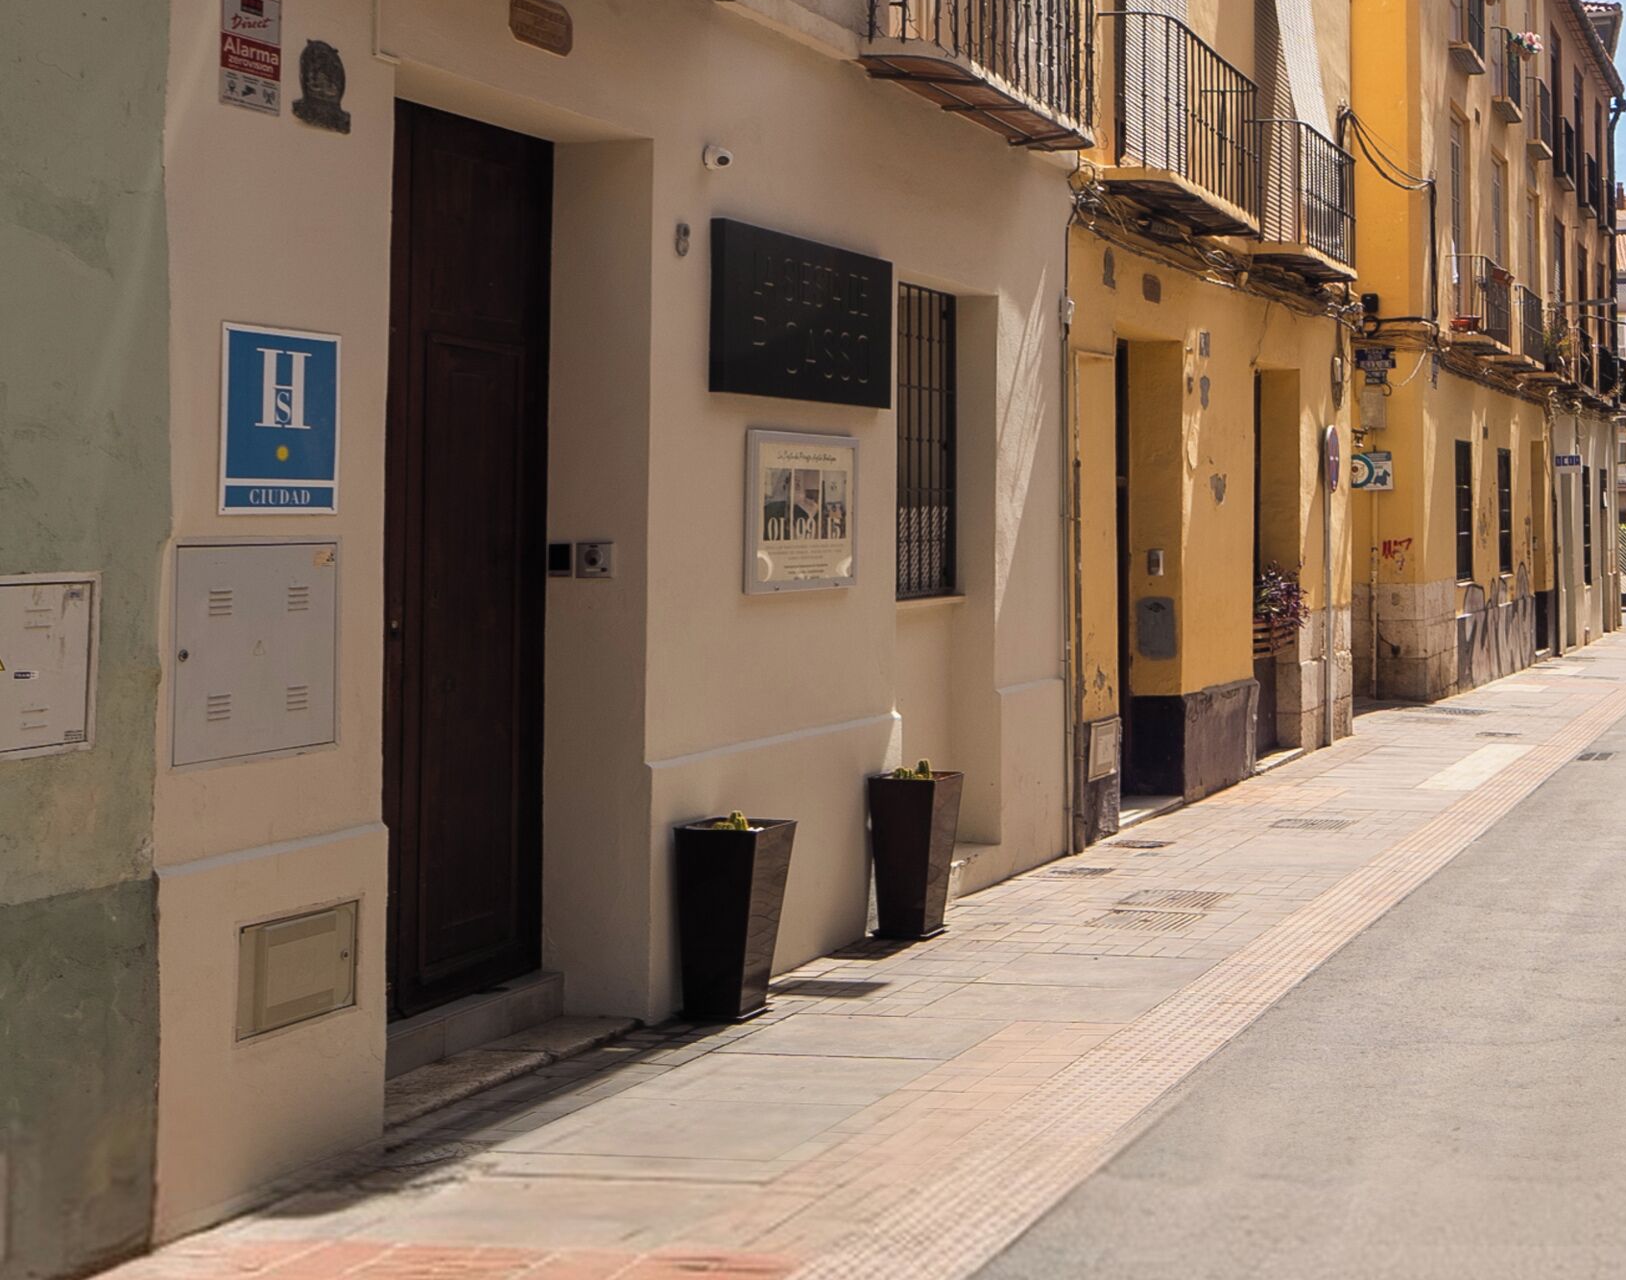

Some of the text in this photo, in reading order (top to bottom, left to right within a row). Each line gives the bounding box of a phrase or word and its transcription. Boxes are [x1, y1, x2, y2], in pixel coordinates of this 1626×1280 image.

[231, 13, 272, 30] Direct
[223, 37, 279, 66] Alarma
[753, 315, 870, 383] PCASSO
[249, 489, 311, 505] CIUDAD
